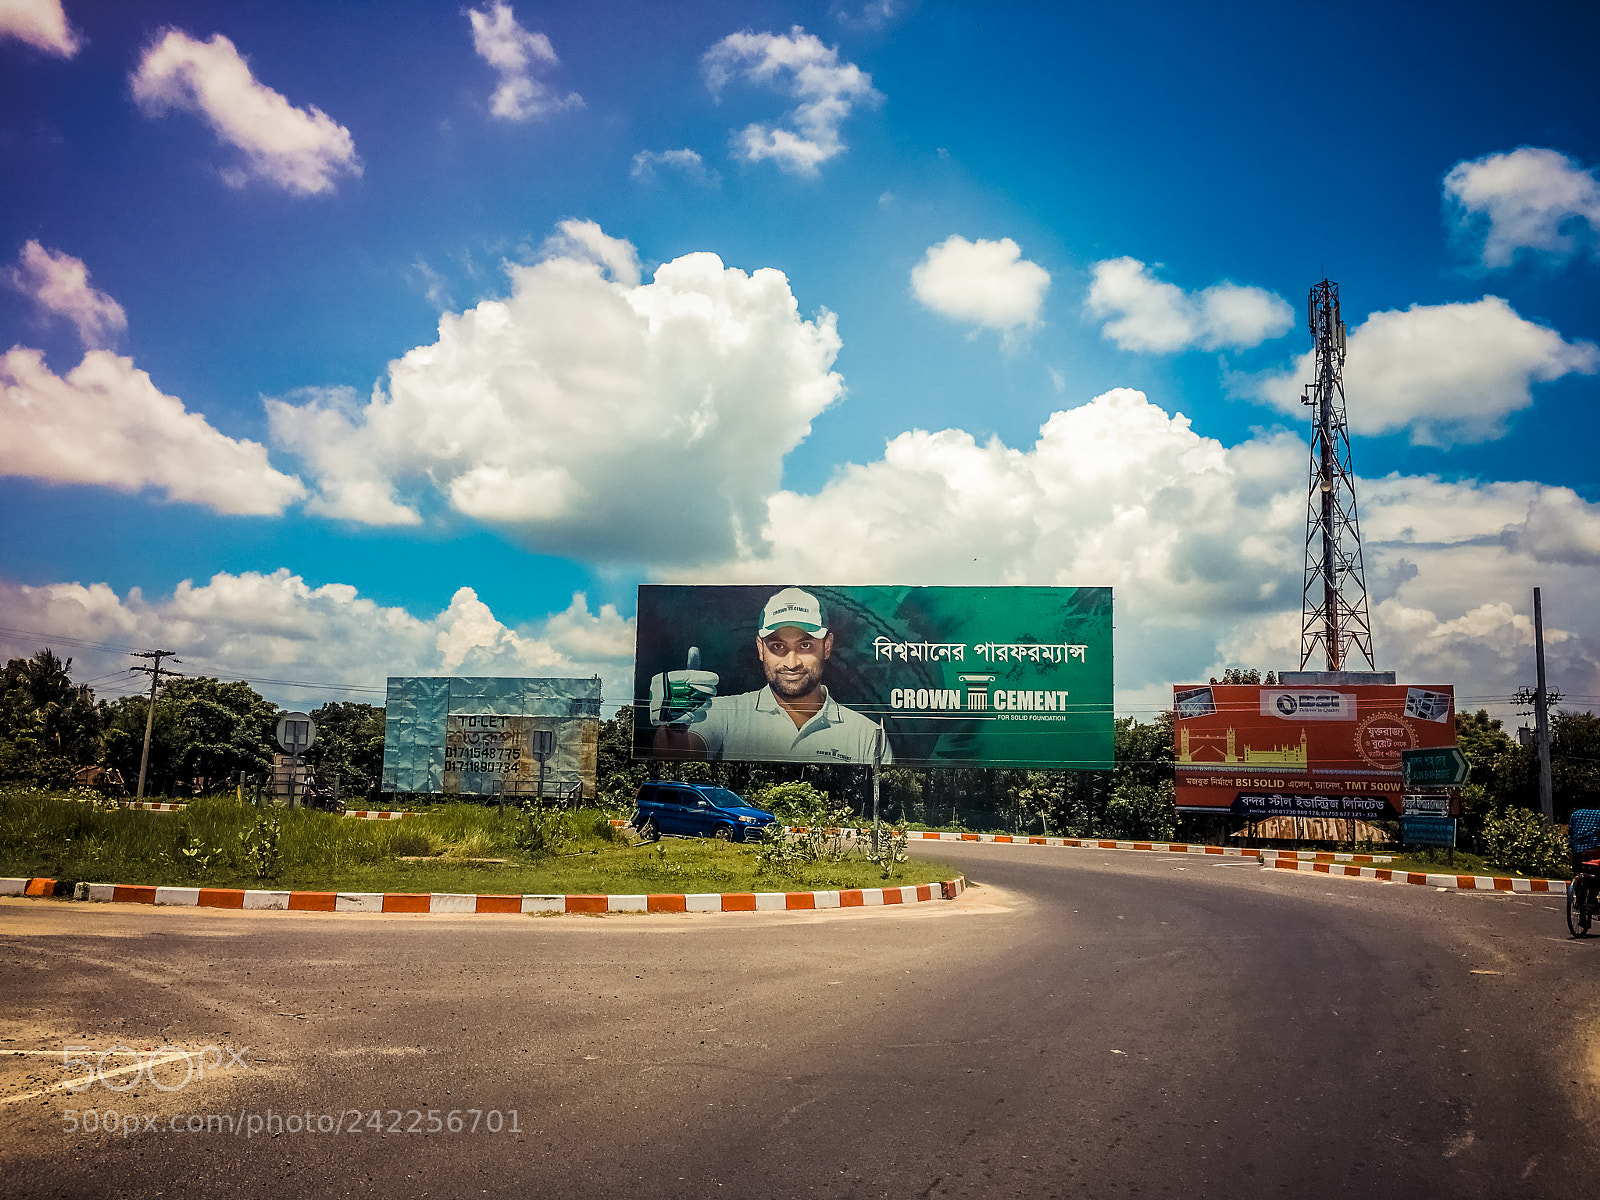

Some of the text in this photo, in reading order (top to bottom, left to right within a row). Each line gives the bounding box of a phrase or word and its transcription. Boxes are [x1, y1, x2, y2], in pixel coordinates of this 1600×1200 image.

[872, 635, 1088, 664] বিশ্বমানের পারফরম্যান্স
[890, 688, 1069, 711] CROWN CEMENT
[1299, 695, 1340, 708] BSI
[1010, 714, 1028, 722] SOLID
[1029, 714, 1066, 722] FOUNDATION
[446, 746, 521, 760] 01711548775
[444, 761, 520, 773] 01711890734
[1236, 778, 1252, 787] BSI
[1254, 778, 1285, 788] SOLID
[1344, 781, 1368, 790] TMT
[1370, 782, 1401, 792] 500W
[1240, 796, 1266, 806] বন্দর
[1342, 796, 1386, 810] লিমিটেড
